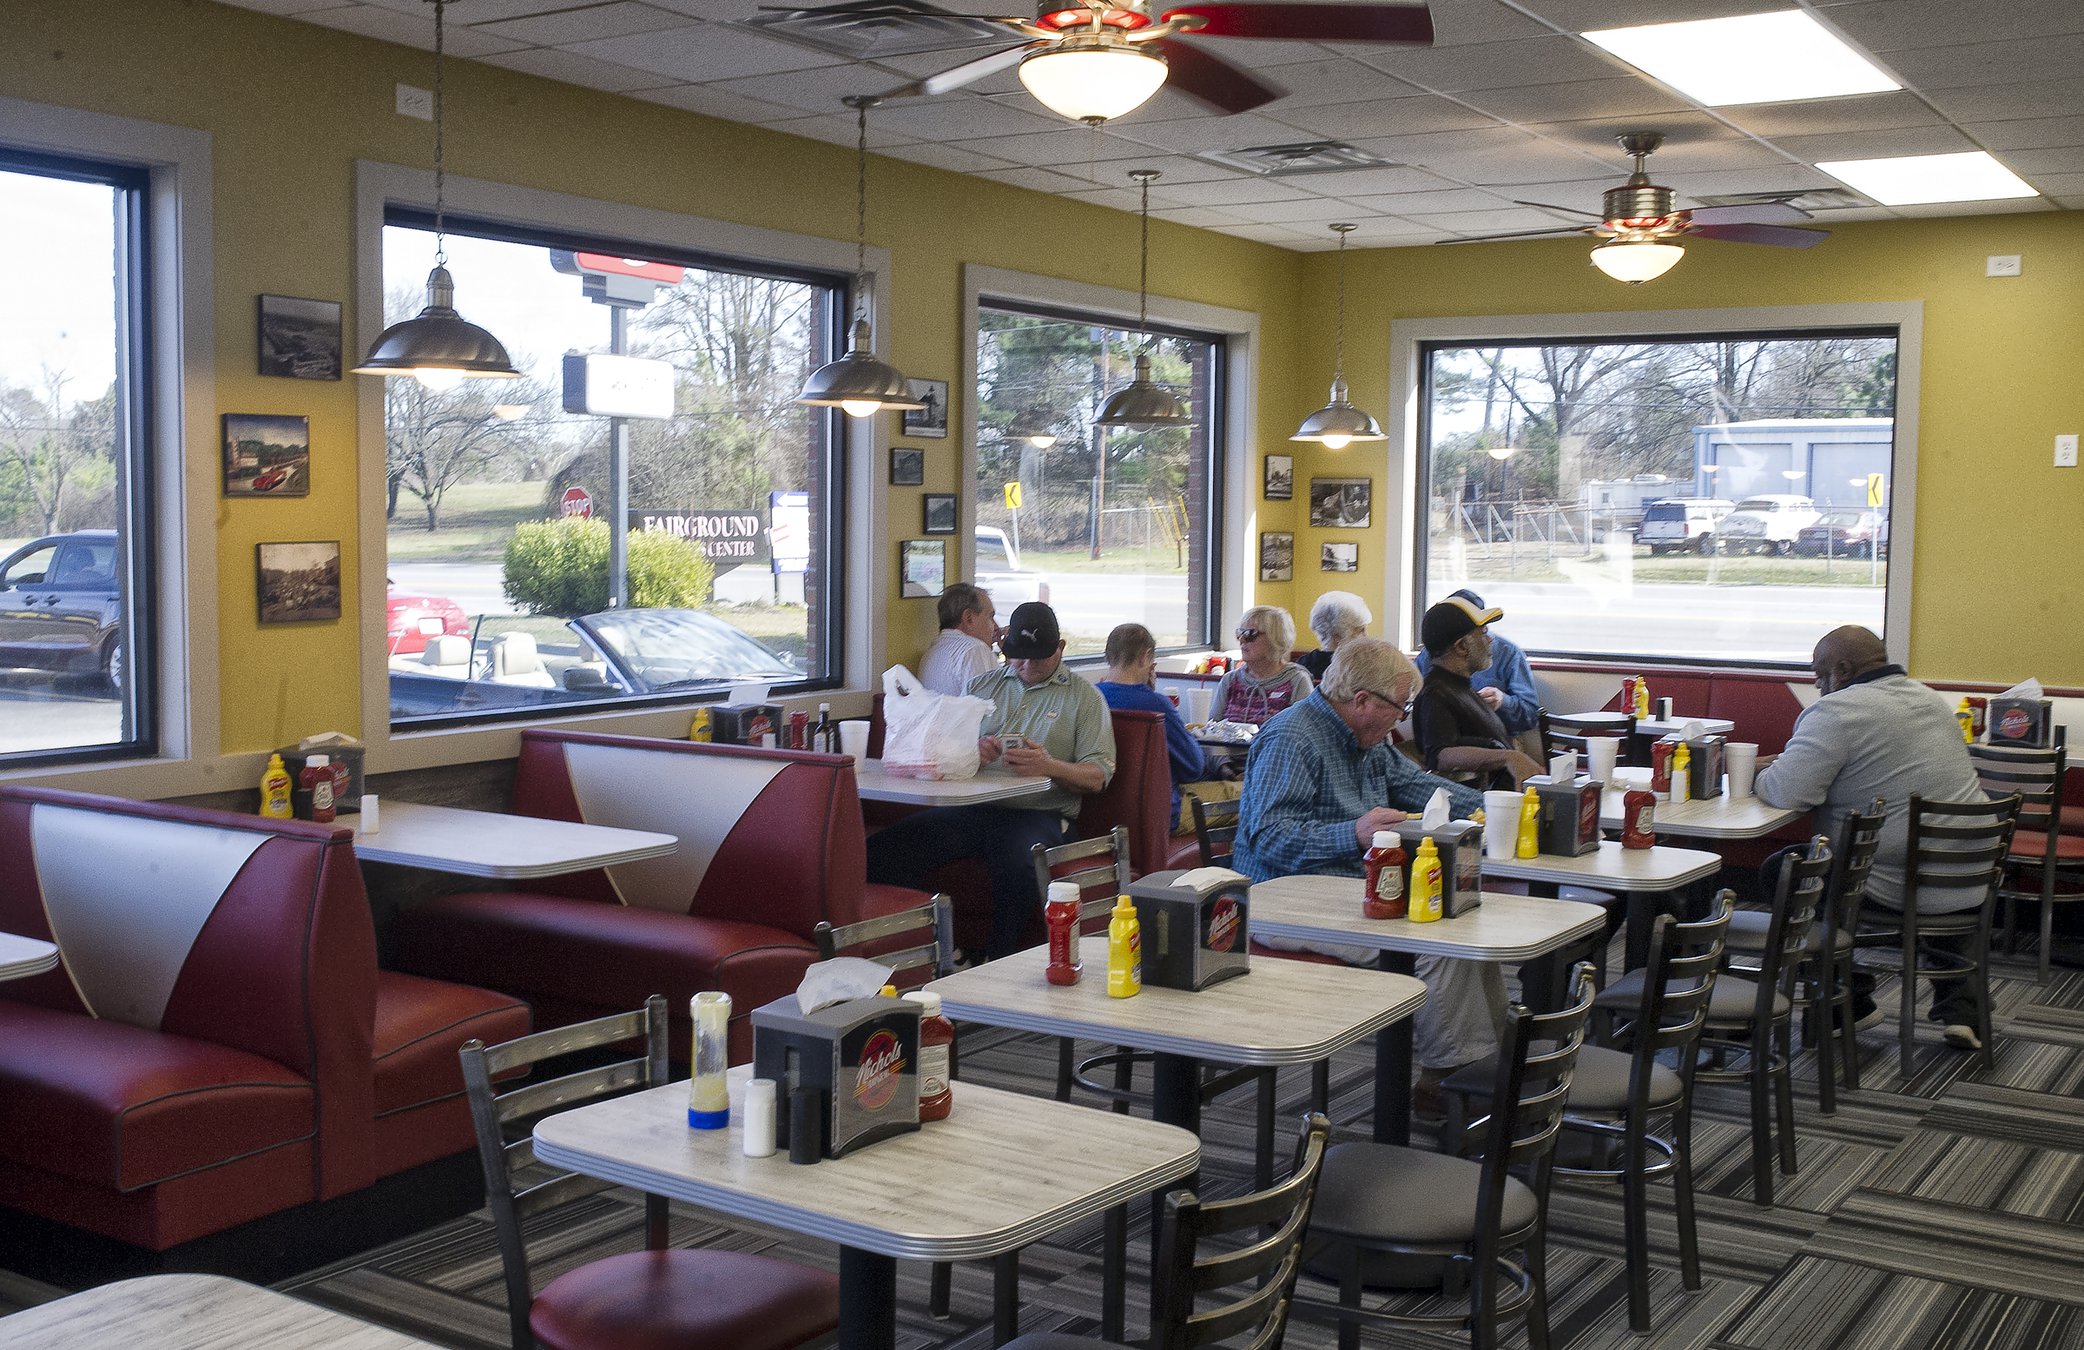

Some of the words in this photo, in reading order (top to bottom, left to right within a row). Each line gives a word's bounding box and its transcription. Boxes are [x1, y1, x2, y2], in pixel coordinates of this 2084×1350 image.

[563, 498, 590, 514] STOP
[643, 515, 759, 537] FAIRGROUND
[708, 541, 755, 557] CENTER
[855, 1040, 902, 1088] Nichols
